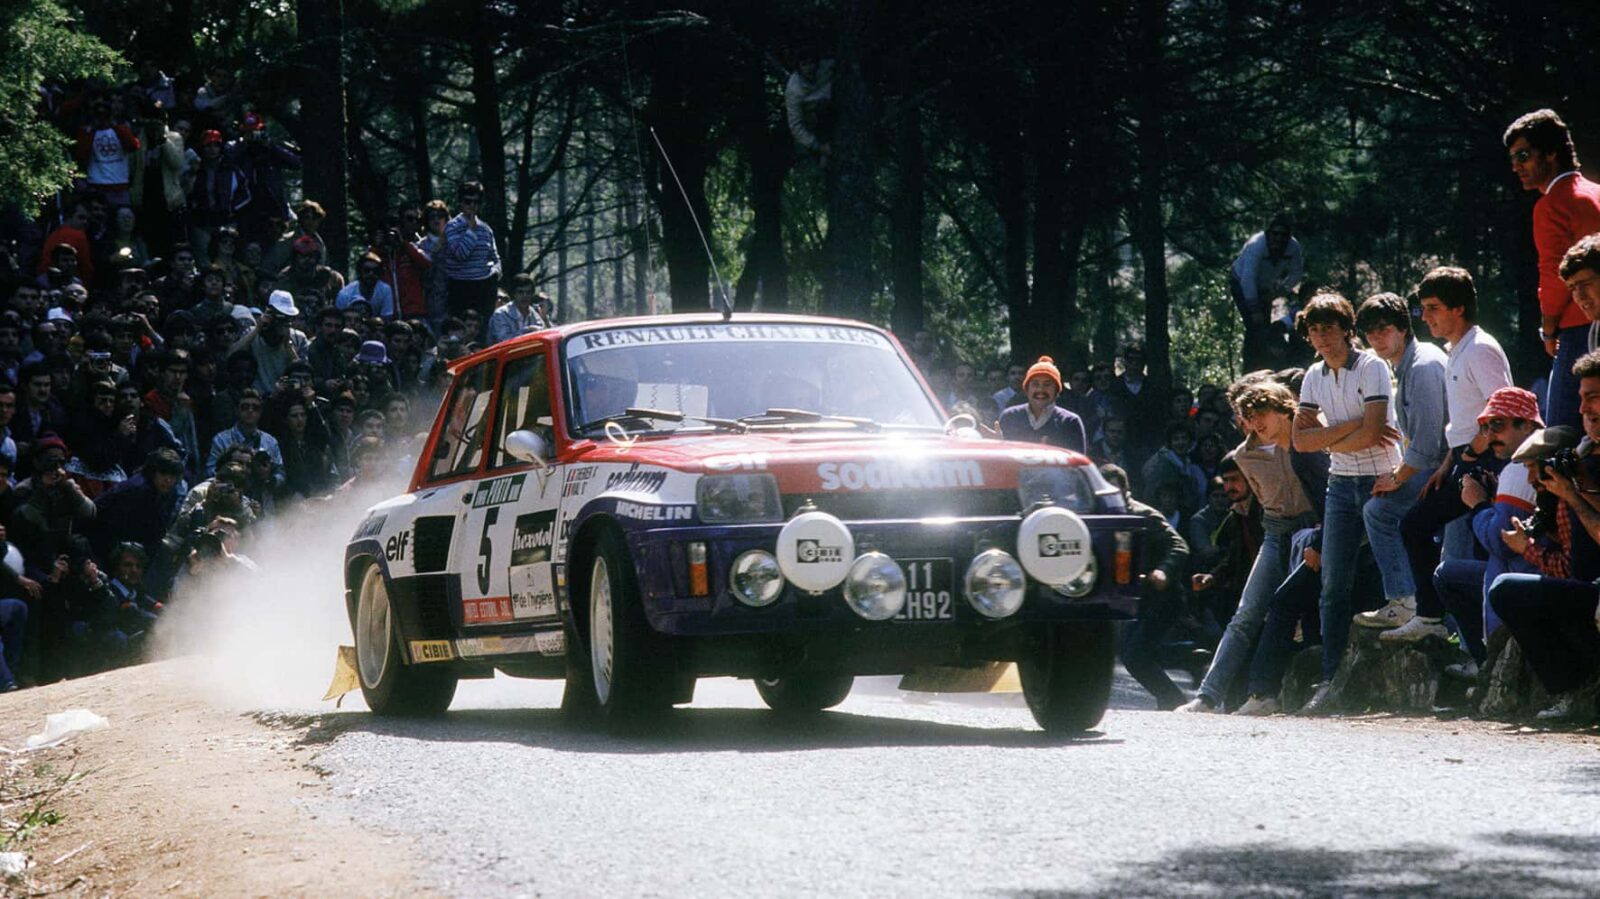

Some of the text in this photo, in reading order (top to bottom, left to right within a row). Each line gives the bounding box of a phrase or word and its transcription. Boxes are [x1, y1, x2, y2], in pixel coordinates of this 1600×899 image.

[615, 501, 692, 520] MICHELIN
[386, 530, 410, 562] elf
[477, 506, 500, 596] 5
